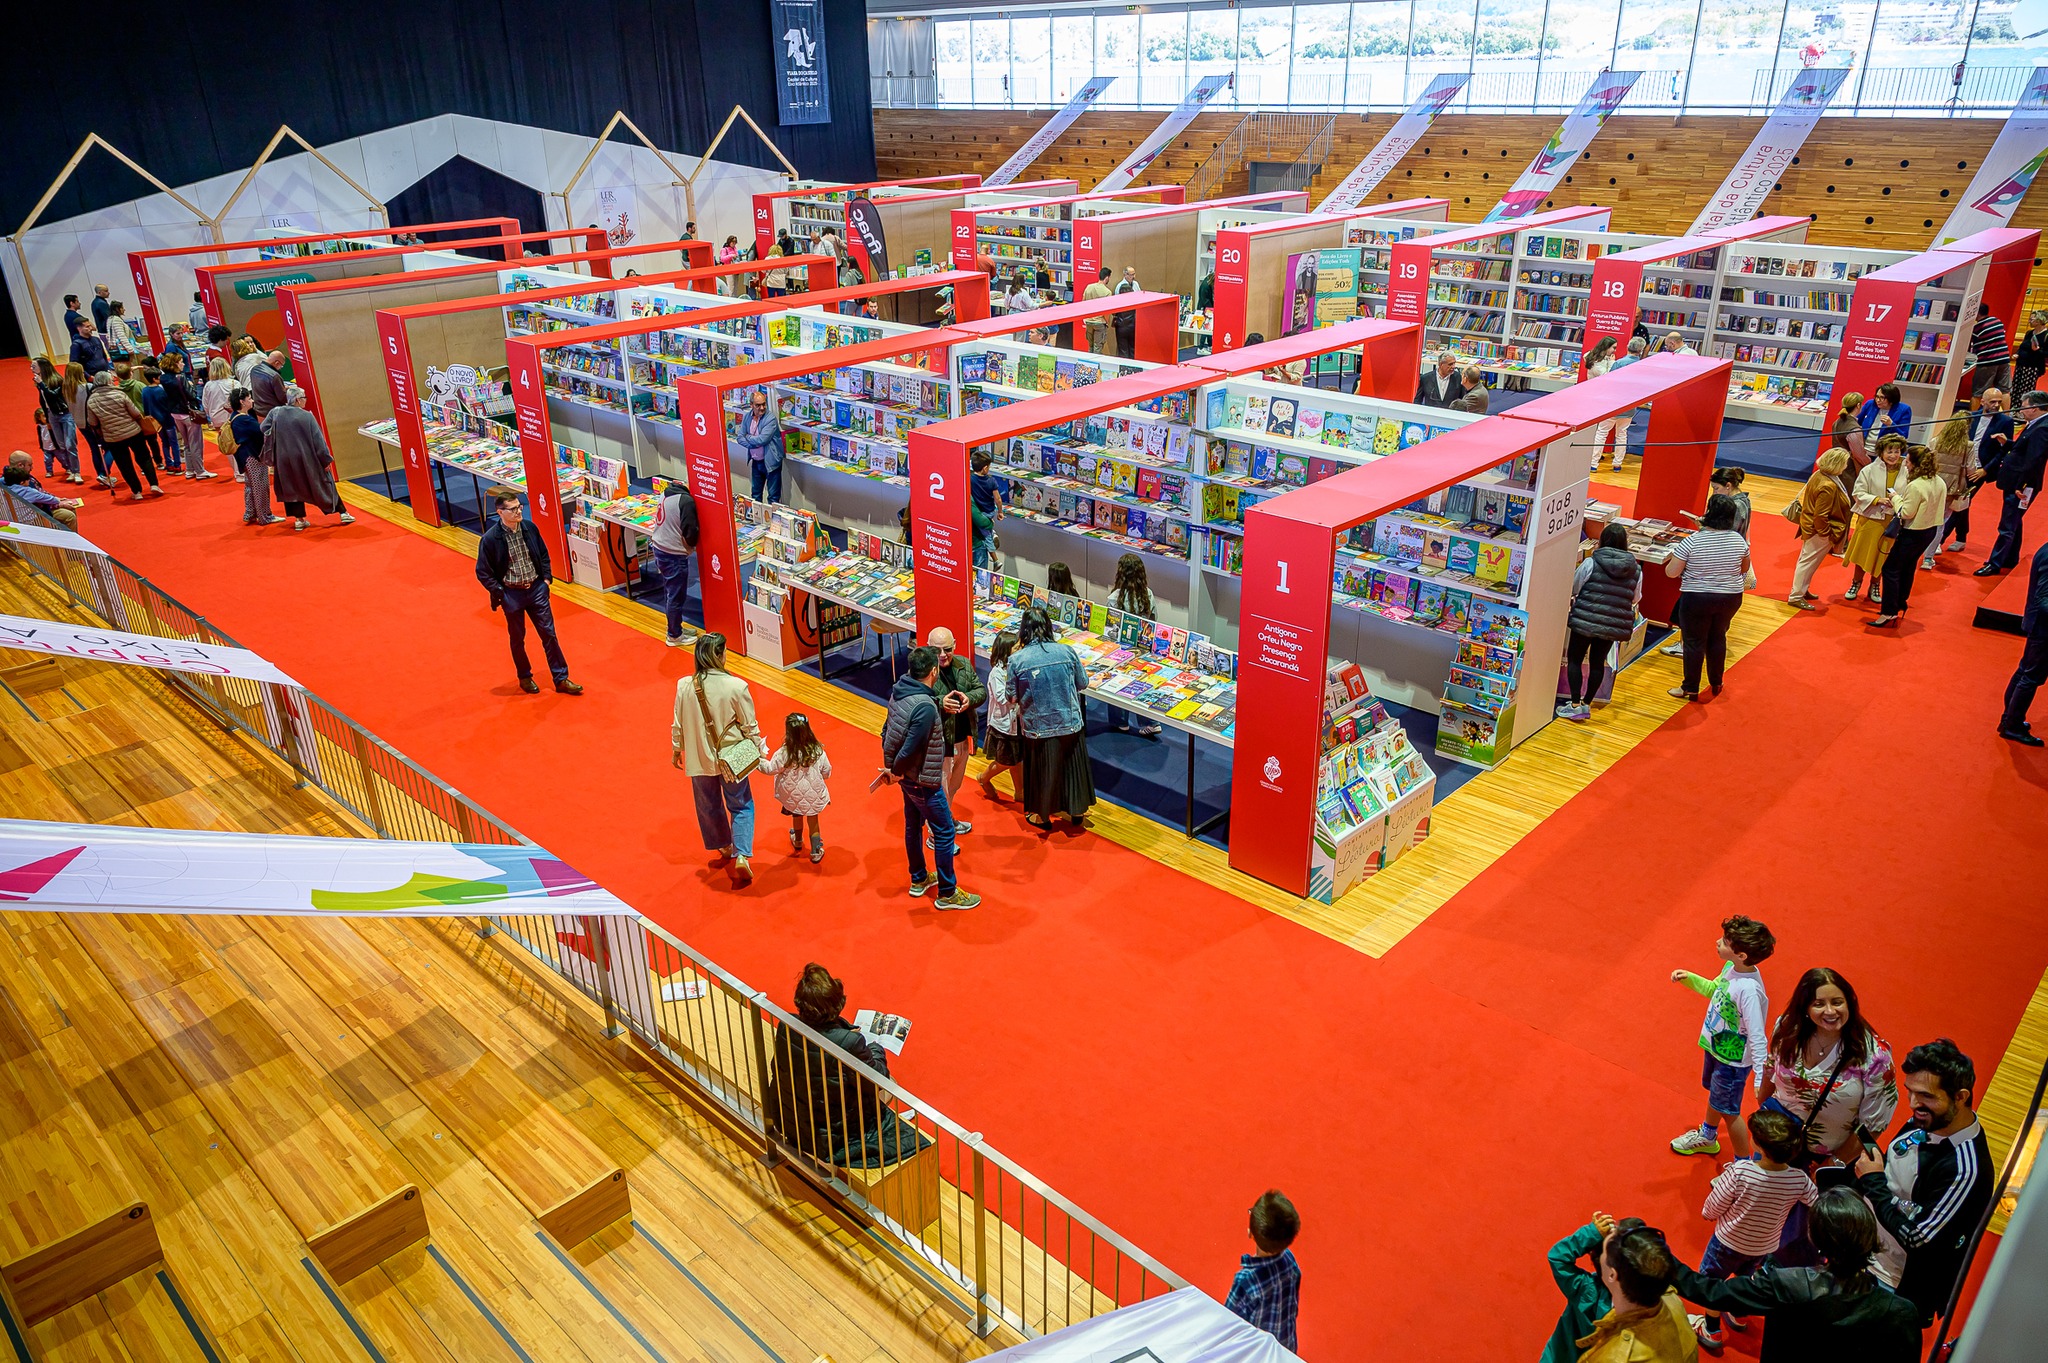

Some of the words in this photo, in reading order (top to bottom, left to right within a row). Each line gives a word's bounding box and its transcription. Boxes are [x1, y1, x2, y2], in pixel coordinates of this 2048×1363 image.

[1016, 130, 1053, 161] Cultura
[1386, 138, 1416, 162] 2025
[1762, 148, 1795, 176] 2025
[1323, 191, 1350, 214] pital
[1347, 177, 1364, 190] da
[1360, 137, 1402, 174] Cultura
[1718, 194, 1739, 208] da
[1730, 145, 1773, 189] Cultura
[757, 208, 768, 220] 24
[956, 225, 970, 239] 22
[1080, 235, 1093, 250] 21
[1222, 248, 1241, 264] 20
[136, 271, 143, 286] 8
[1399, 263, 1418, 279] 19
[1334, 280, 1351, 289] 50%
[1602, 280, 1625, 298] 18
[203, 289, 210, 304] 7
[285, 310, 294, 327] 6
[1865, 303, 1893, 323] 17
[388, 336, 398, 355] 5
[1874, 353, 1890, 361] Livros
[450, 368, 455, 376] O
[455, 370, 474, 378] NOVO
[451, 376, 473, 384] LIVRO!
[520, 369, 530, 390] 4
[694, 412, 707, 436] 3
[929, 472, 945, 501] 2
[926, 525, 950, 537] Marcador
[925, 533, 952, 547] Manuscrito
[929, 543, 949, 555] Penguin
[921, 549, 941, 562] Random
[941, 556, 958, 567] House
[927, 560, 952, 574] Alfaguara
[1275, 560, 1290, 594] 1
[73, 634, 210, 660] Eixo
[1257, 632, 1280, 645] Orfeu
[1280, 638, 1303, 652] Negro
[1262, 644, 1297, 661] Presença
[1259, 654, 1300, 672] Jacarandá
